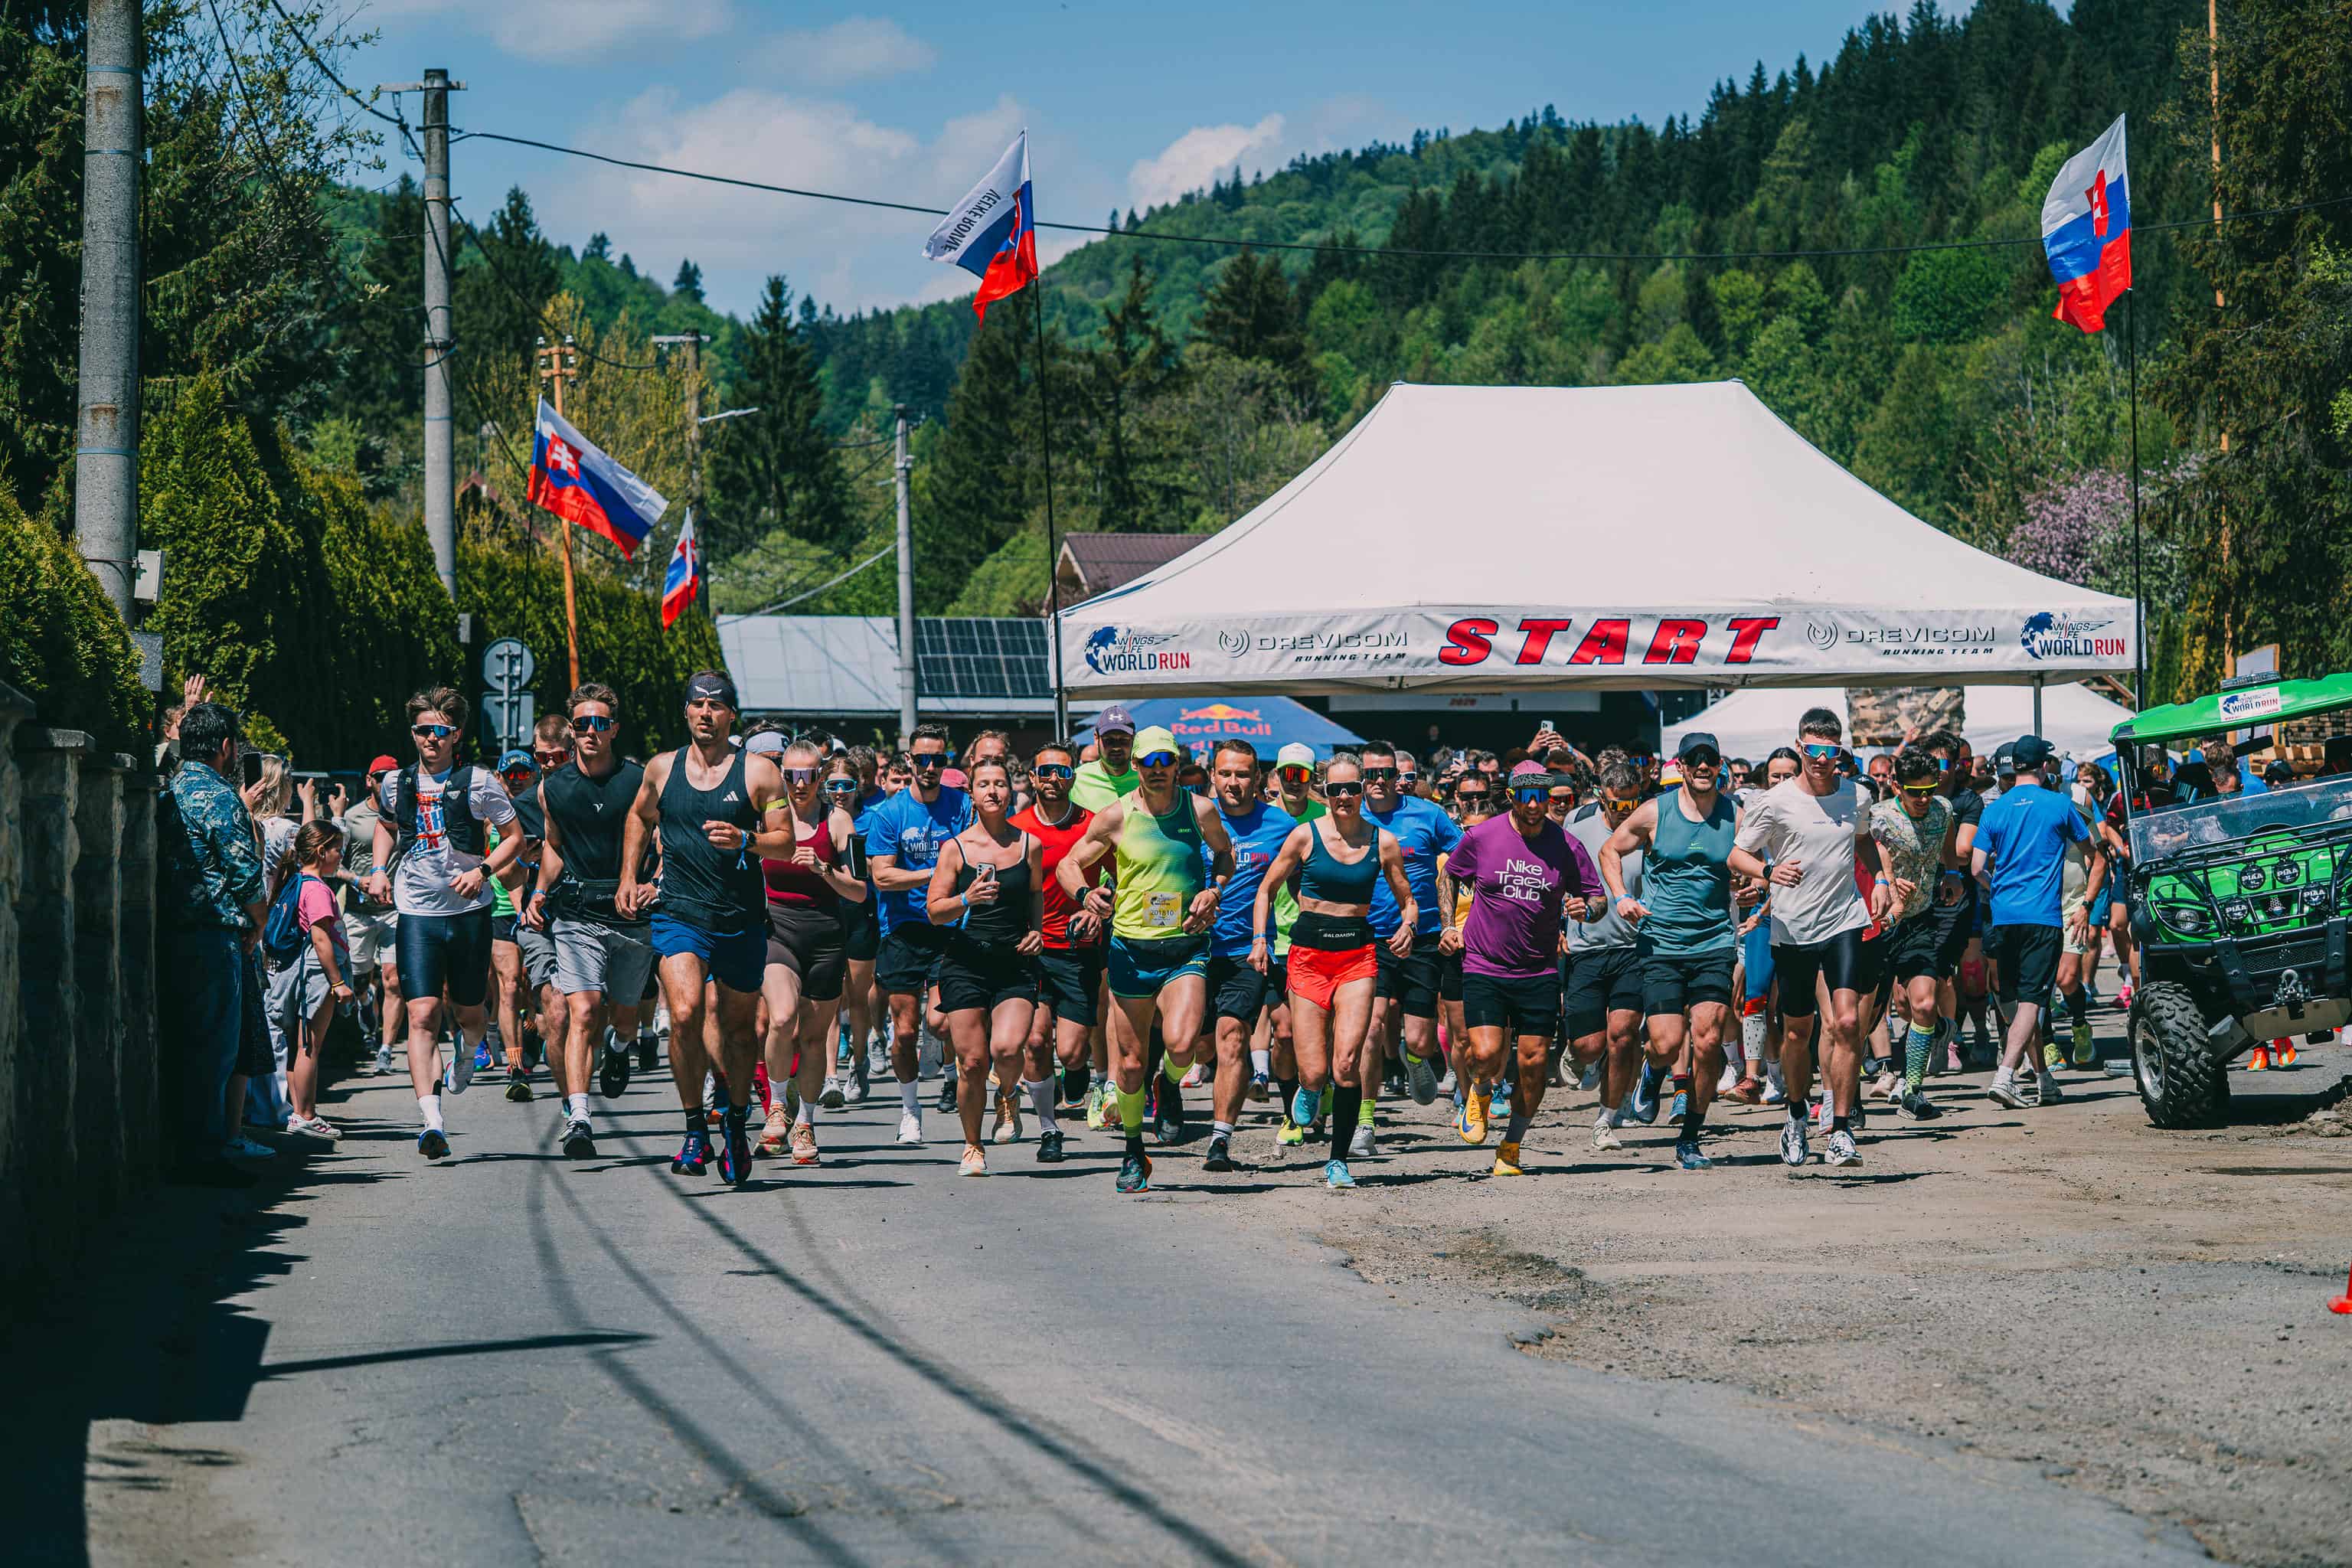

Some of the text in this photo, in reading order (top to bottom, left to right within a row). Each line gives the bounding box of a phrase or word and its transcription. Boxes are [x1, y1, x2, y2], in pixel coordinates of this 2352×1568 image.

[2053, 622, 2090, 631] WINGS
[1844, 626, 1995, 643] DREVICOM
[2058, 630, 2080, 639] LIFE
[1116, 635, 1155, 645] WINGS
[1257, 631, 1408, 651] DREVICOM
[1437, 616, 1782, 666] START
[1122, 645, 1145, 654] LIFE
[1882, 647, 1994, 656] RUNNING TEAM
[2038, 637, 2125, 656] WORLD RUN
[1102, 652, 1191, 671] WORLD RUN
[1295, 652, 1407, 662] RUNNING TEAM
[2261, 697, 2279, 708] RUN
[1171, 720, 1272, 736] Red Bull
[1506, 858, 1544, 876] Nike
[2241, 872, 2263, 882] PIAA
[2277, 868, 2298, 877] PIAA
[1494, 871, 1553, 892] Track
[1503, 885, 1540, 901] Club
[2303, 889, 2326, 898] PIAA
[2225, 904, 2247, 913] PIAA
